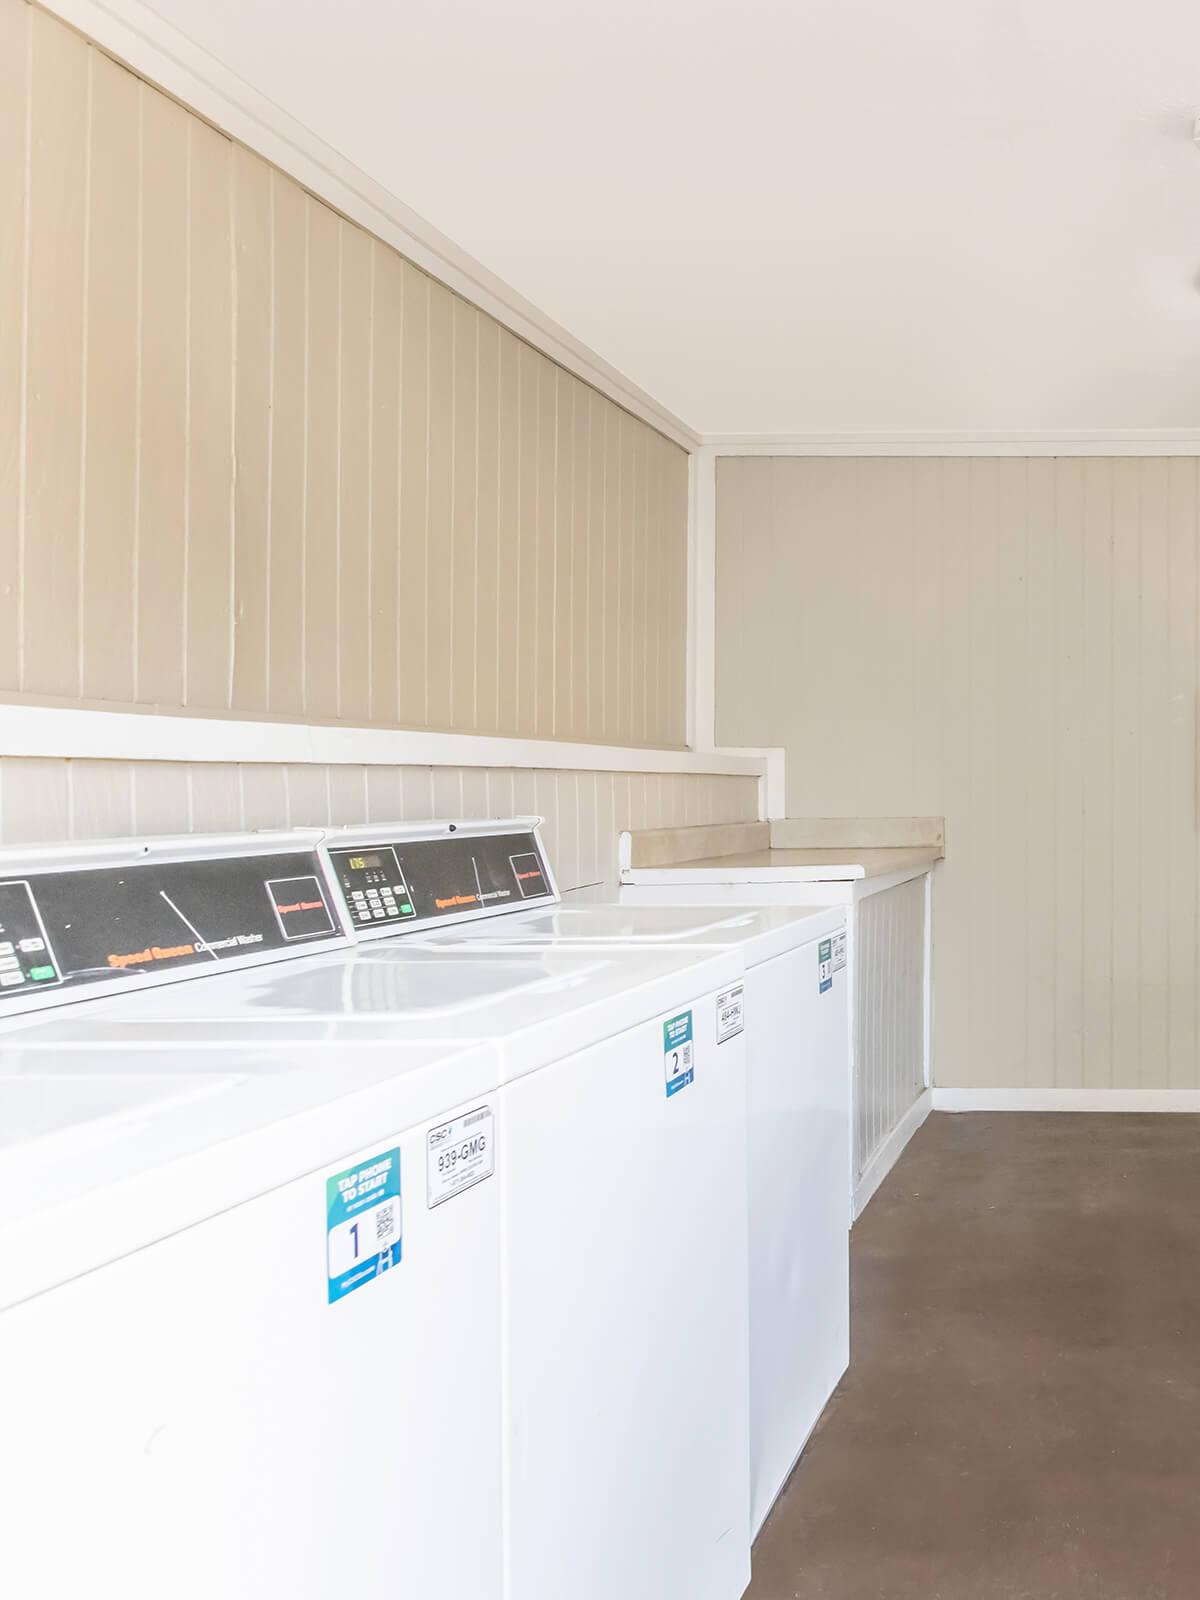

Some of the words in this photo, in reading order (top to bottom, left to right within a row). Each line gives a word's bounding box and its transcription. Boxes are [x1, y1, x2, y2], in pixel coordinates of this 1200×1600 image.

[672, 1052, 680, 1075] 2
[430, 1129, 447, 1144] CSC
[438, 1135, 486, 1172] 939-GMG
[338, 1174, 358, 1192] TAP
[358, 1158, 392, 1183] PHONE
[342, 1187, 357, 1203] TO
[357, 1172, 388, 1196] START
[350, 1222, 359, 1259] 1
